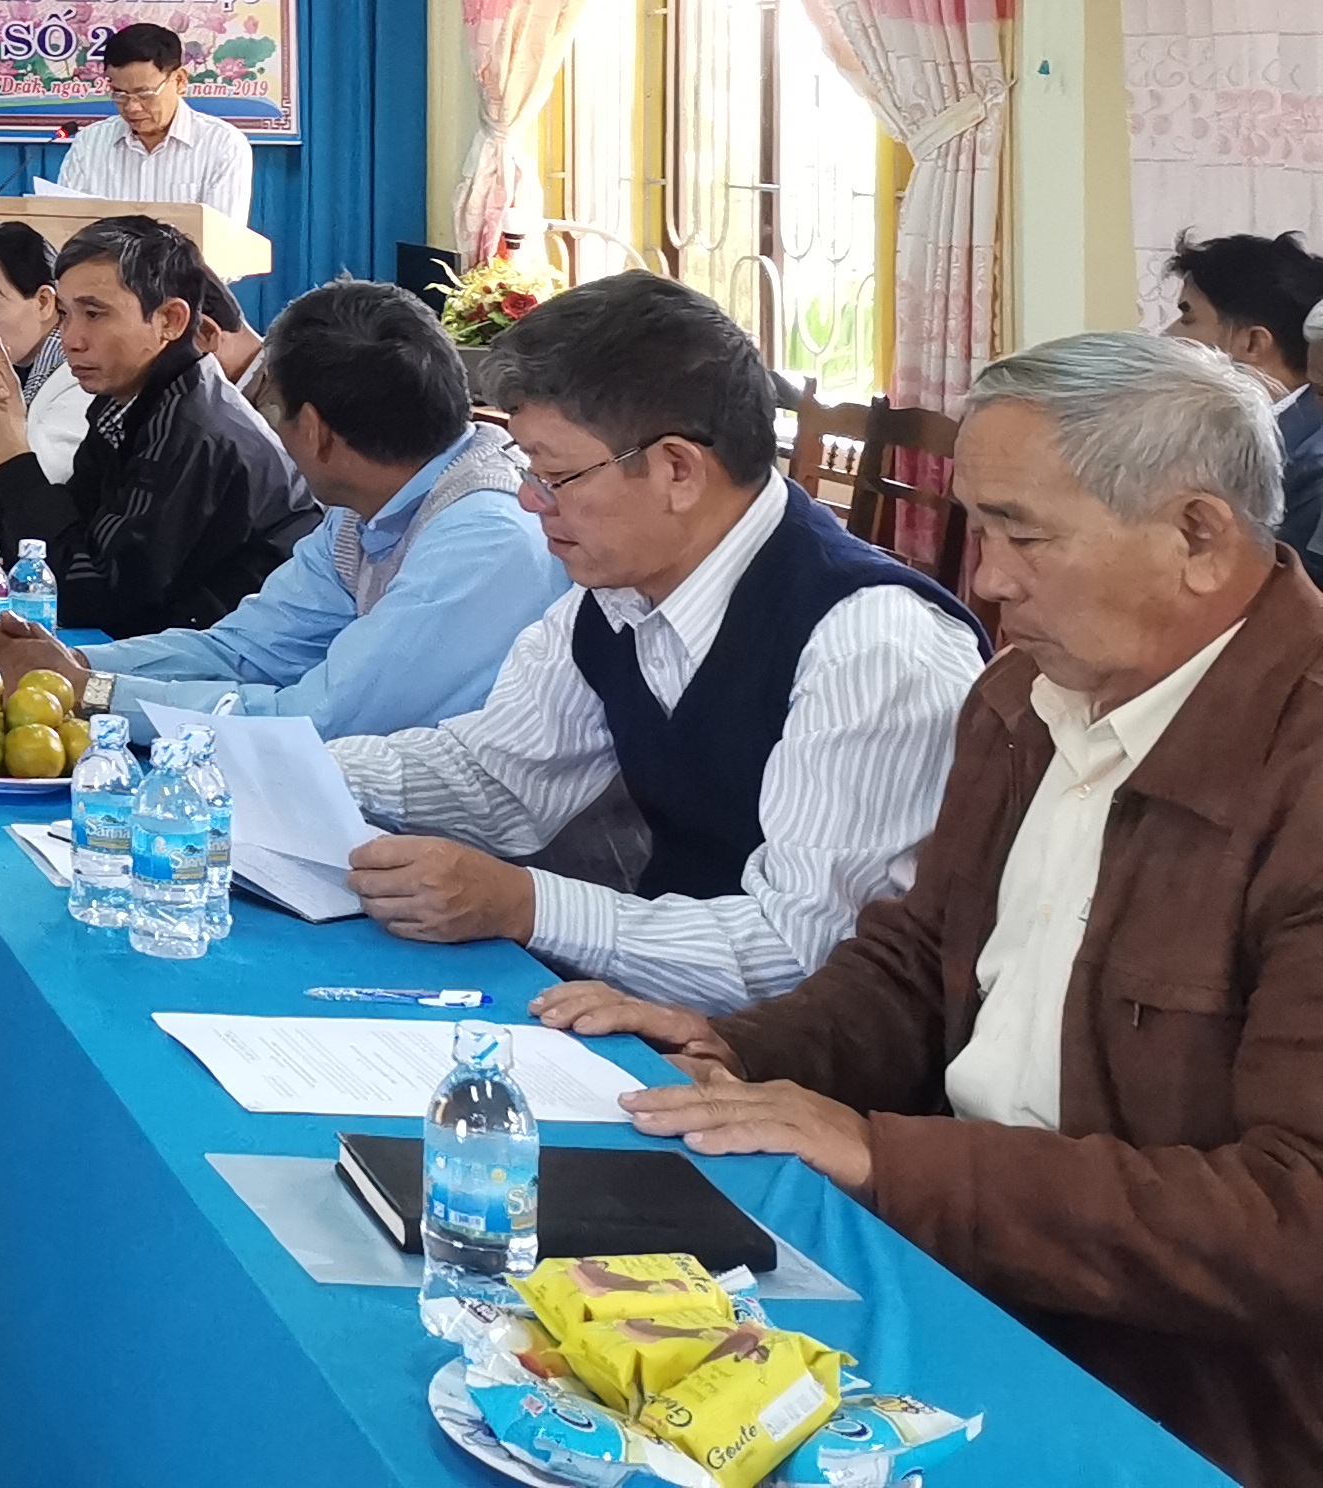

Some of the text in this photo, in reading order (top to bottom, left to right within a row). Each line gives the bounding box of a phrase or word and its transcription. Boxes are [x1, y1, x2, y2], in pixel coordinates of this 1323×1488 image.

[4, 10, 74, 58] SỐ
[52, 78, 90, 98] ngày
[192, 82, 227, 96] năm
[233, 80, 269, 96] 2019
